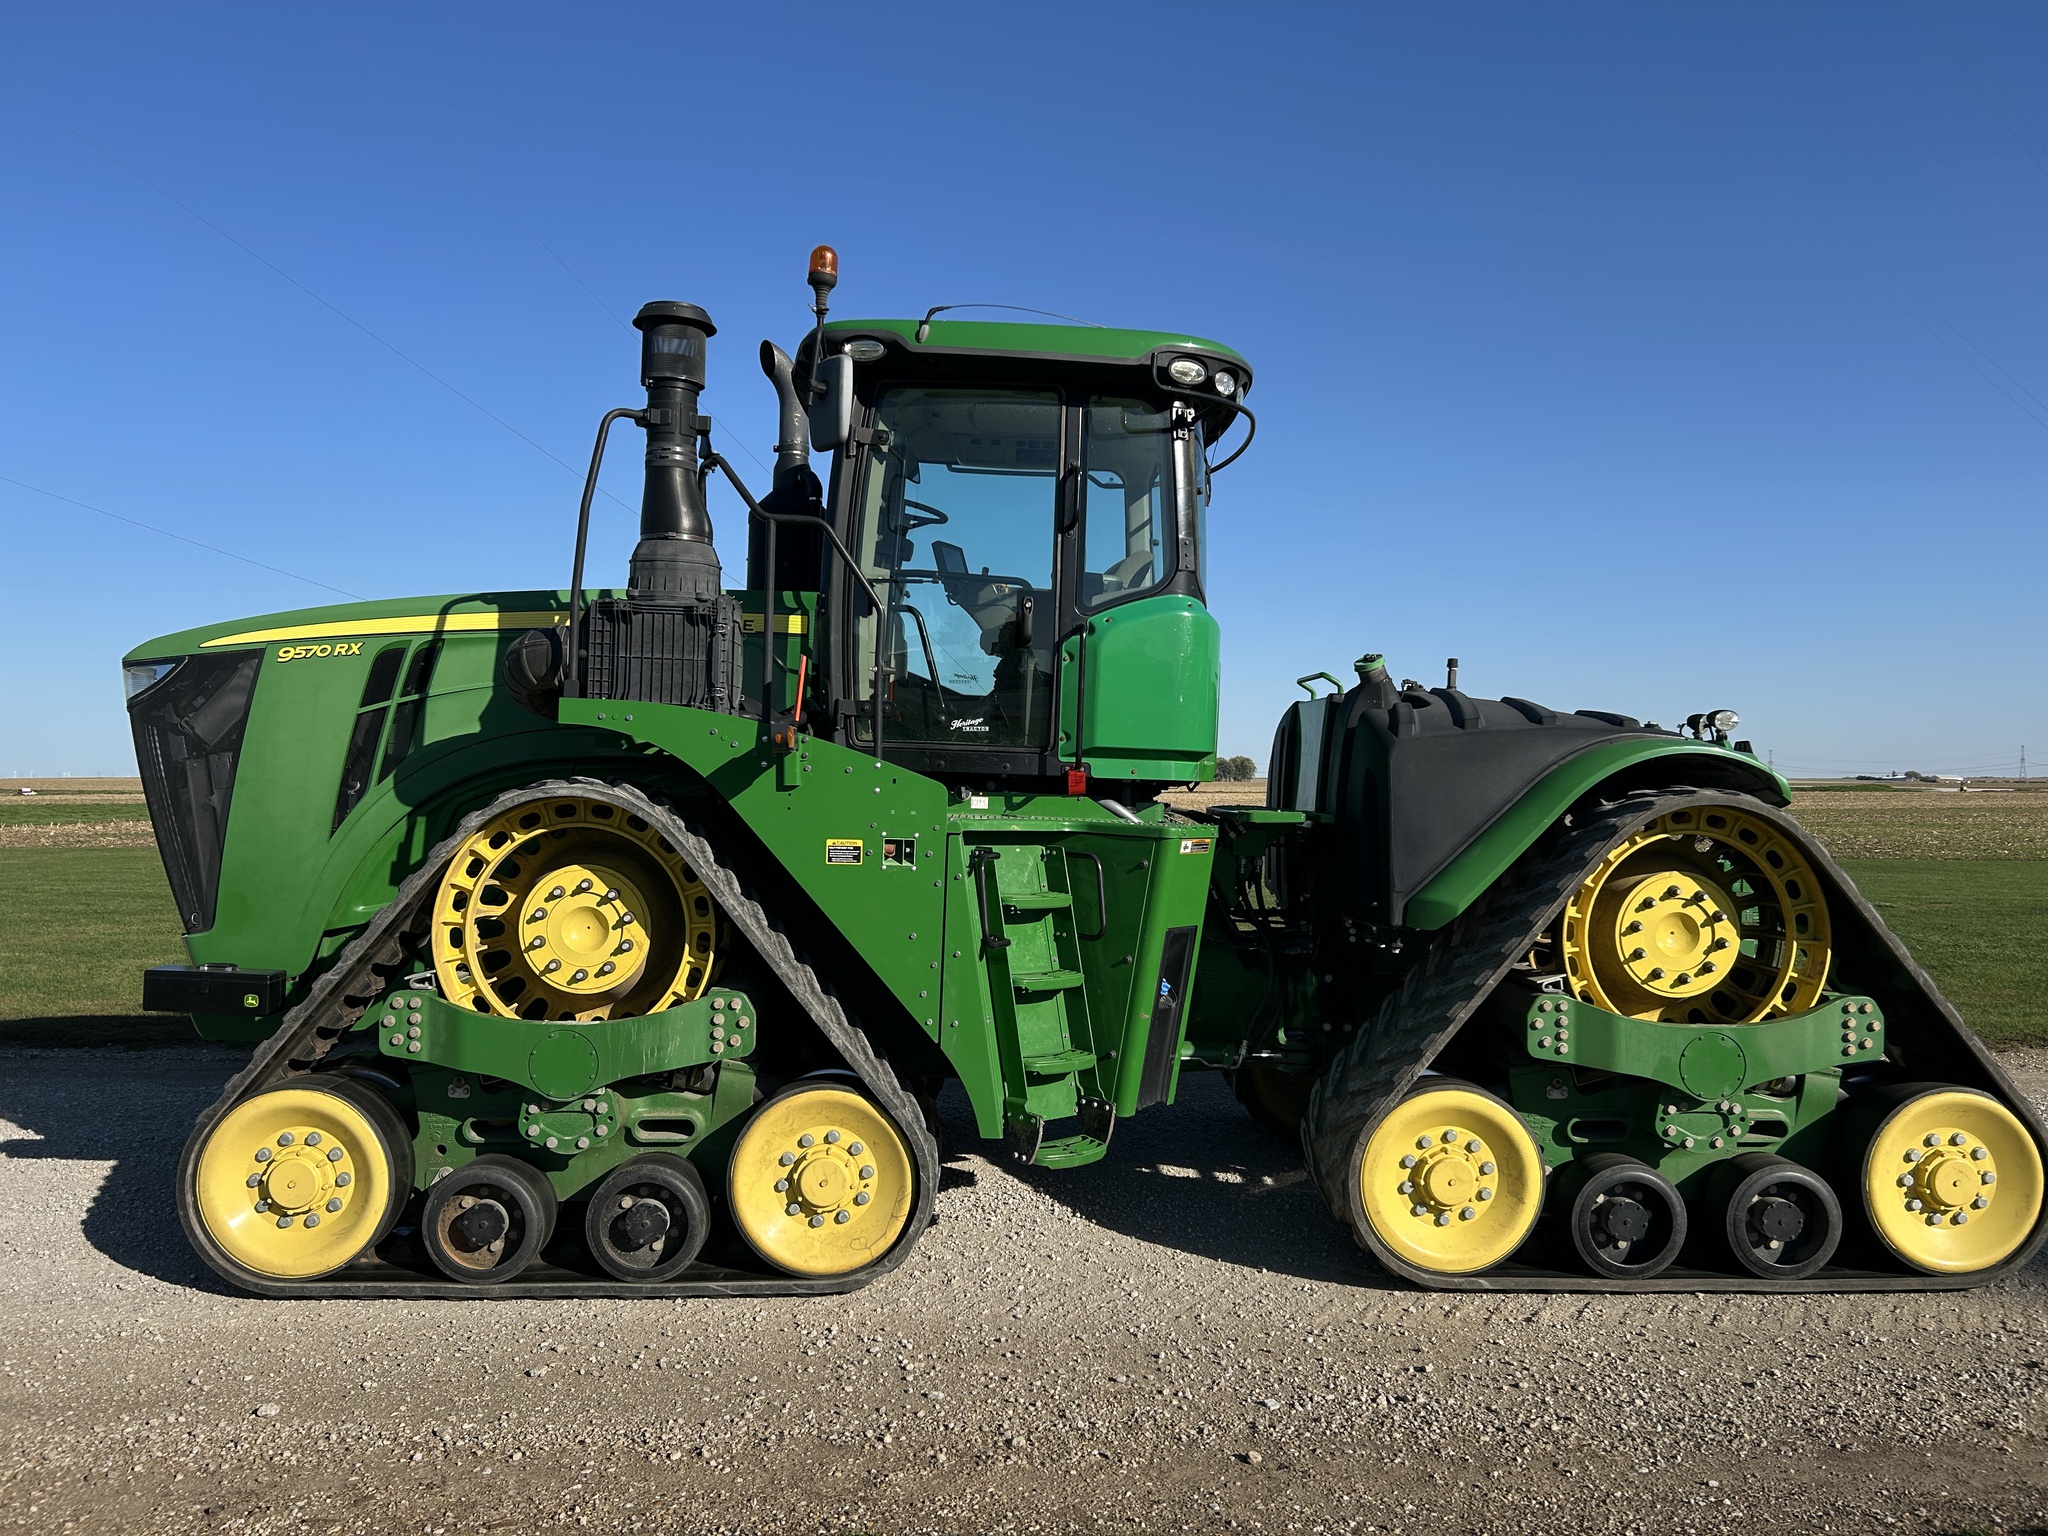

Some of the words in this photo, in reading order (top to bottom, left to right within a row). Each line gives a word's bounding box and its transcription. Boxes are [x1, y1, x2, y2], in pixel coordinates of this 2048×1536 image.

[277, 644, 332, 663] 9570
[333, 642, 365, 656] RX
[950, 718, 984, 730] Heritage
